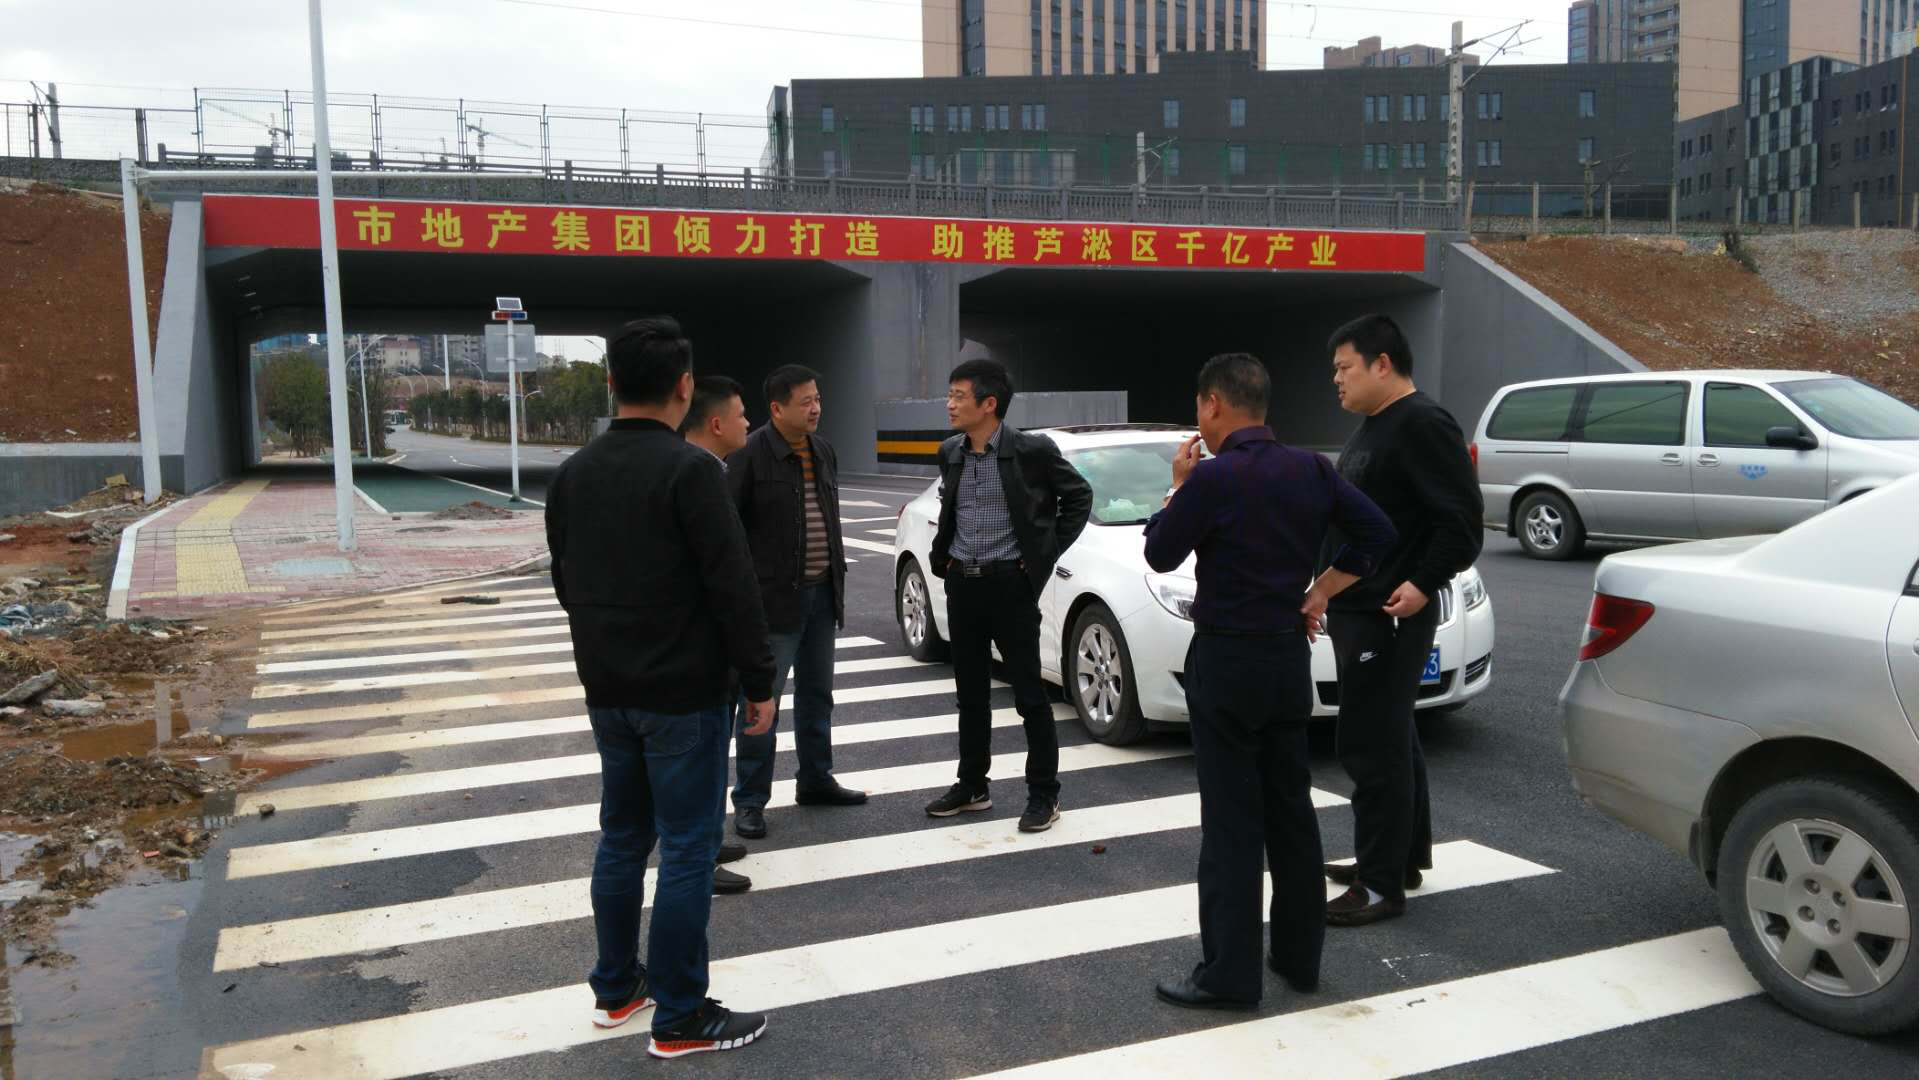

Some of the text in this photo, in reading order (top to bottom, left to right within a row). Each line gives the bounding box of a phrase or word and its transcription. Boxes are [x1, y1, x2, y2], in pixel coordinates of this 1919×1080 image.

[352, 206, 1336, 266] 市地产集团倾力打造 助推芦淞区千亿产业
